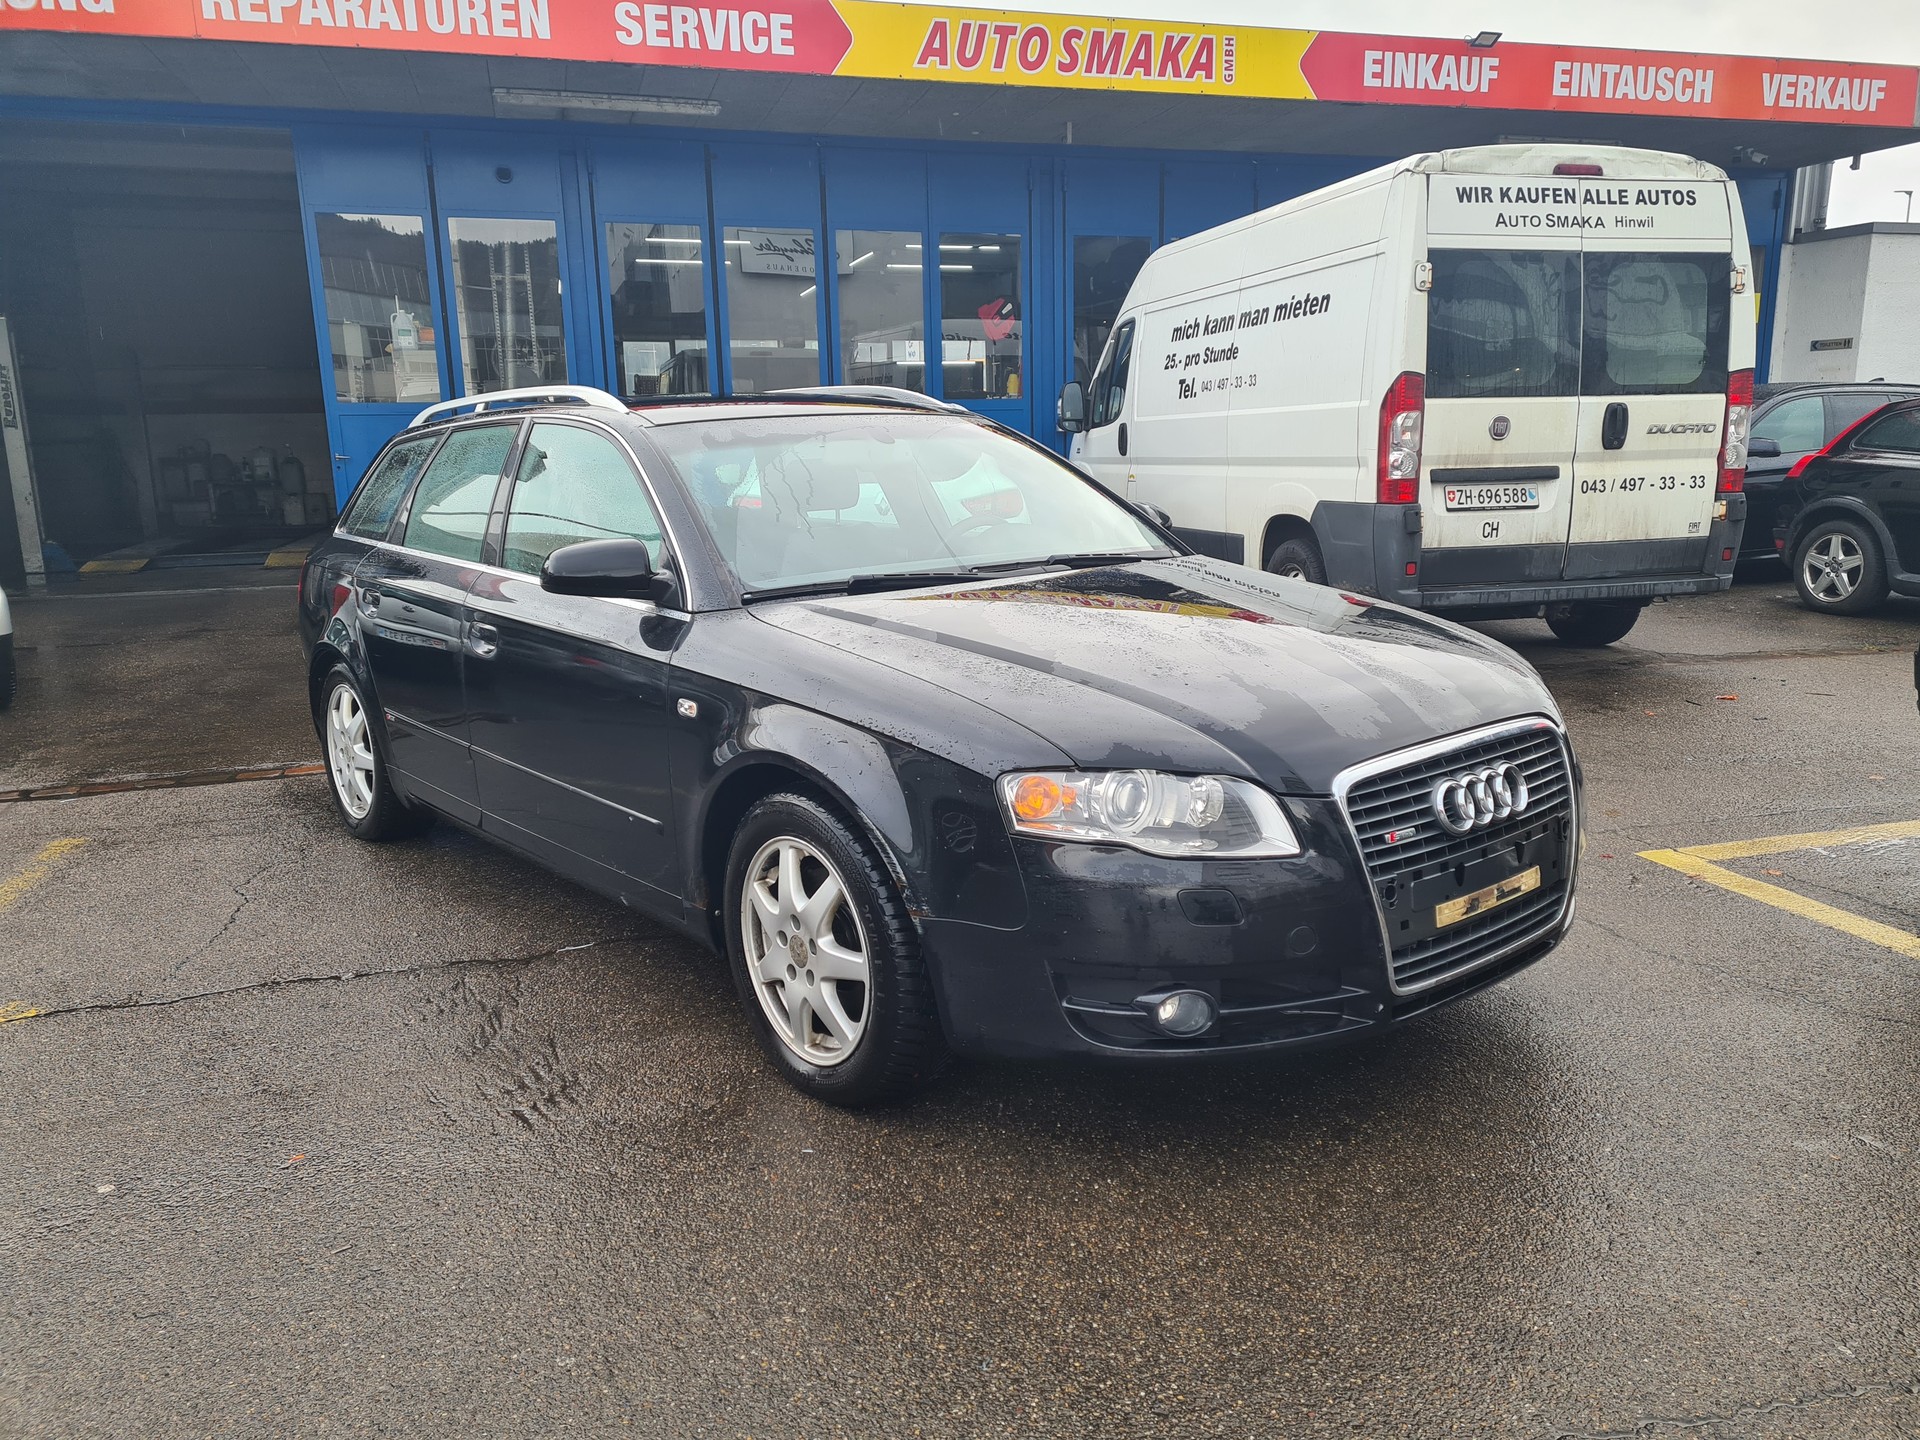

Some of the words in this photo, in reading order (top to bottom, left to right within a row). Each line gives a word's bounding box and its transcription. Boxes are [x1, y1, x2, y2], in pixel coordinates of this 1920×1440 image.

[614, 1, 795, 56] SERVICE
[913, 17, 1052, 73] AUTO
[1055, 25, 1217, 83] SMAKA
[1221, 35, 1236, 85] GMBH
[1363, 49, 1500, 94] EINKAUF
[1552, 60, 1715, 105] EINTAUSCH
[1762, 72, 1888, 113] VERKAUF
[1455, 186, 1494, 204] WIR
[1499, 187, 1577, 205] KAUFEN
[1582, 189, 1629, 206] ALLE
[1635, 189, 1698, 206] AUTOS
[1614, 215, 1655, 229] Hinwil
[1171, 317, 1200, 343] mich
[1202, 313, 1236, 337] kann
[1237, 306, 1270, 330] man
[1272, 292, 1332, 323] mieten
[1183, 353, 1201, 371] pro
[1202, 342, 1239, 365] Stunde
[1177, 377, 1198, 400] Tel.
[1646, 422, 1718, 435] DUCATO
[1482, 521, 1500, 539] CH
